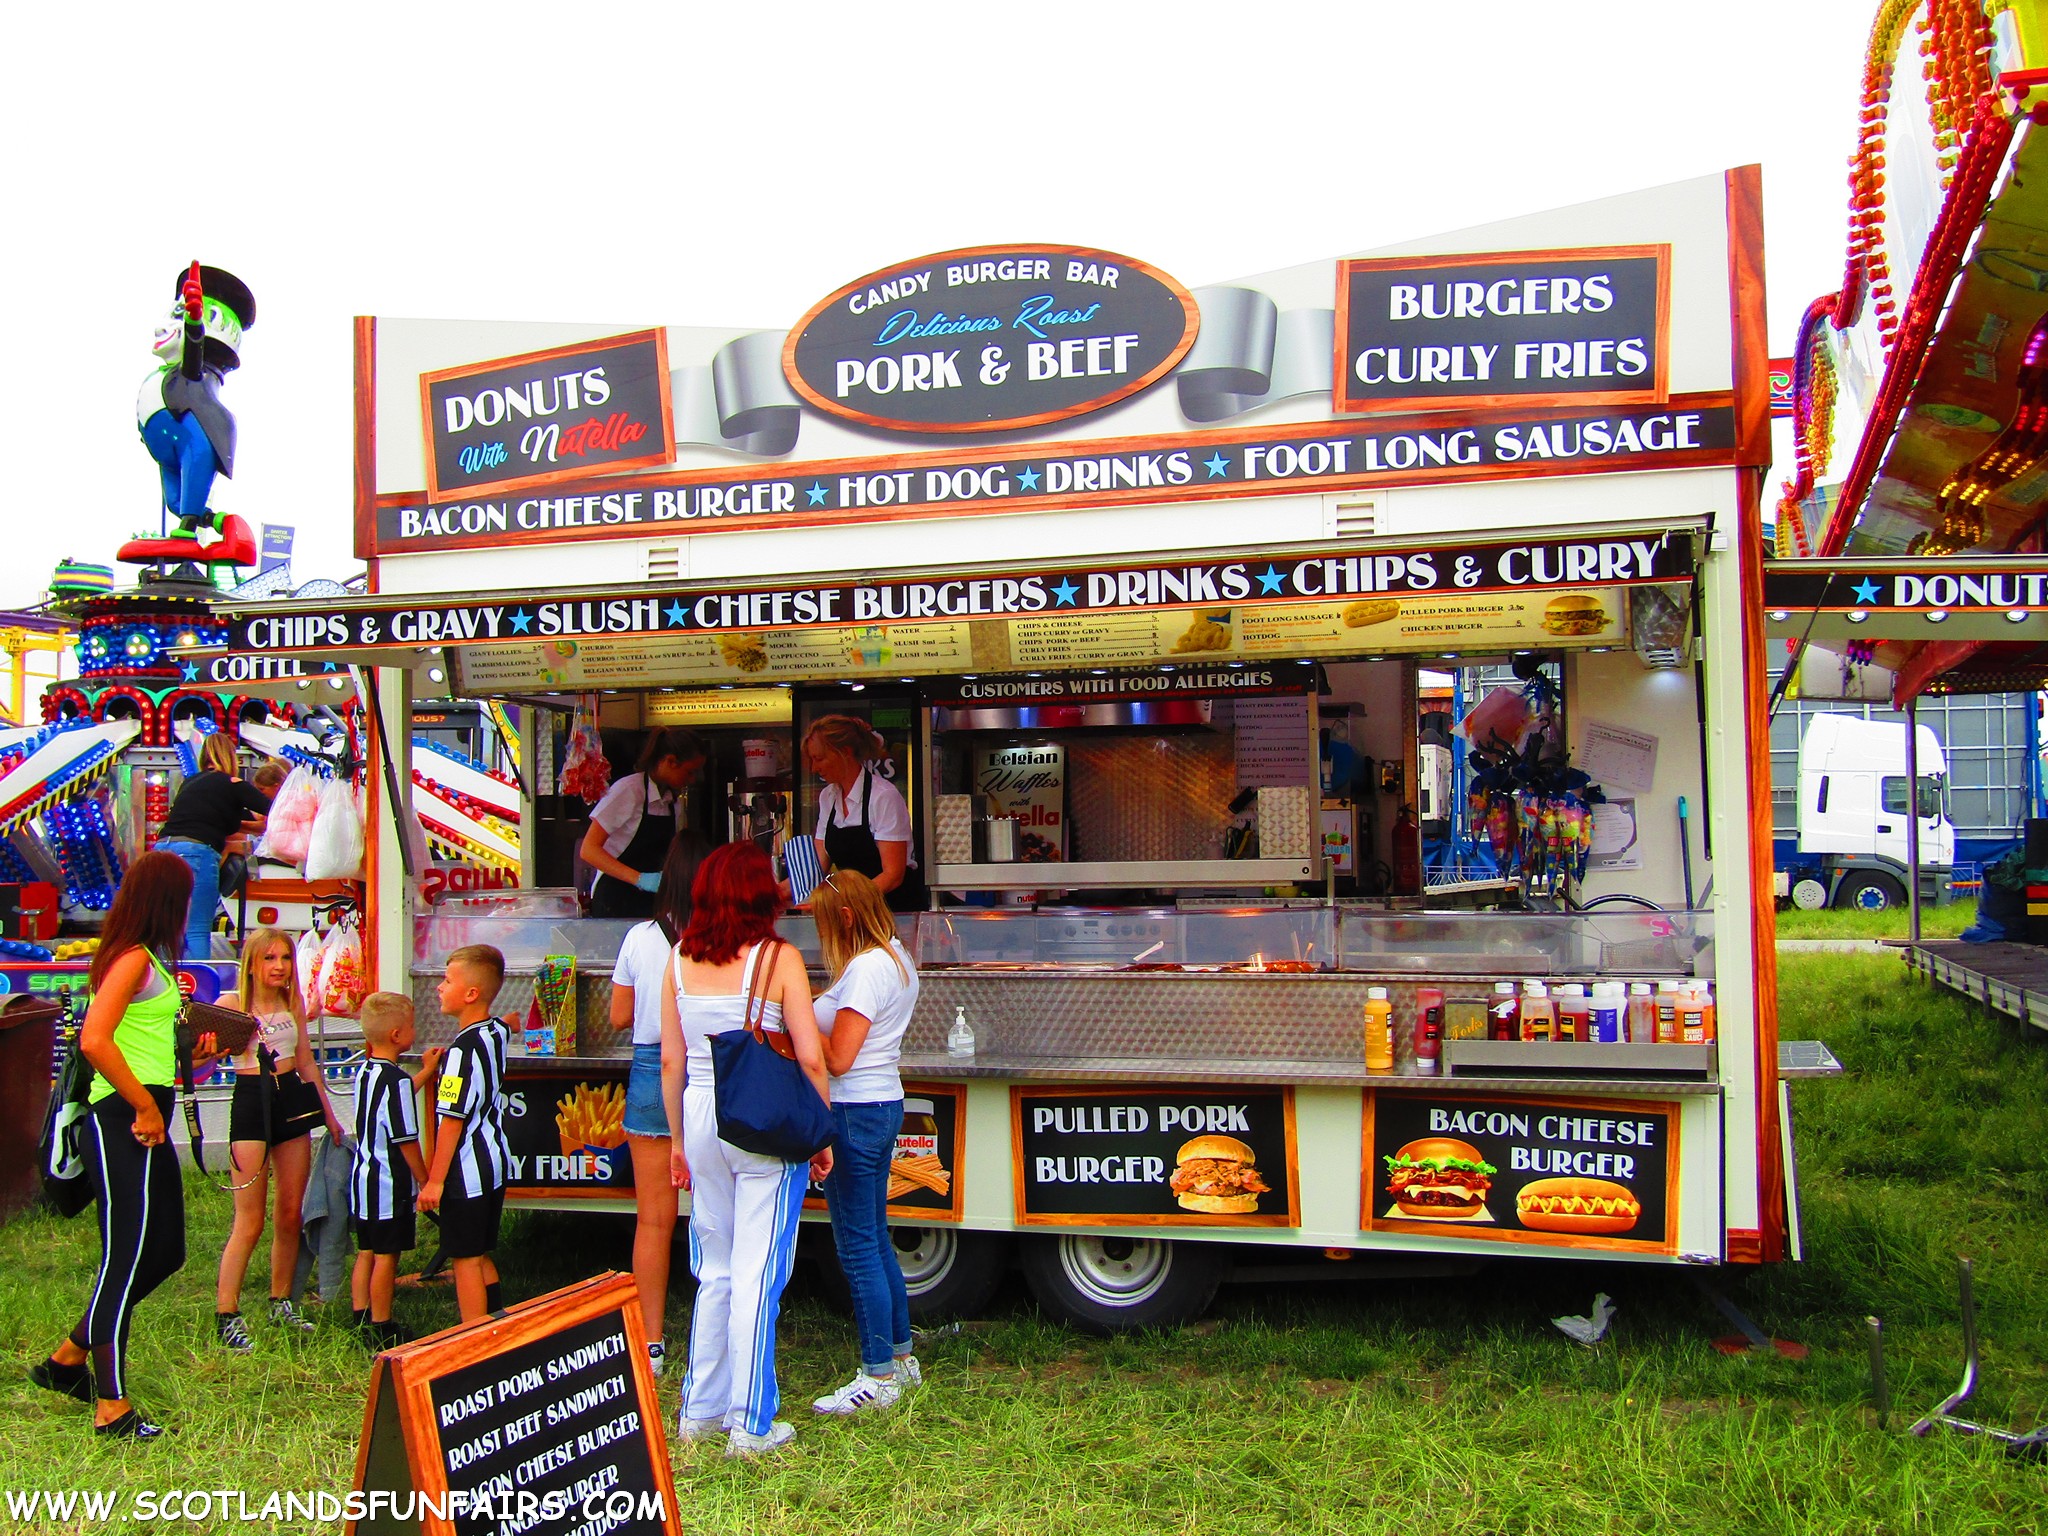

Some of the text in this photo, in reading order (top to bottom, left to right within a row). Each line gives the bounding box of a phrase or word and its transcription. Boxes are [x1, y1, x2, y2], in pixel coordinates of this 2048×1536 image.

[848, 259, 1119, 315] CANDY BURGER BAR
[1389, 274, 1613, 321] BURGERS
[873, 295, 1101, 346] Delicious Roast
[836, 334, 1139, 398] PORK & BEEF
[1355, 337, 1647, 384] CURLY FRIES
[445, 366, 610, 433] DONUTS
[458, 412, 648, 474] With Nutella
[1244, 415, 1700, 480] FOOT LONG SAUSAGE
[839, 465, 1009, 508] HOT DOG
[1046, 452, 1193, 493] DRINKS
[401, 482, 796, 538] BACON CHEESE BURGER
[1088, 564, 1250, 607] DRINKS
[1292, 540, 1660, 595] CHIPS & CURRY
[694, 576, 1047, 628] CHEESE BURGERS
[1894, 575, 2048, 606] DONUT
[247, 606, 504, 649] CHIPS & GRAVY
[538, 600, 659, 634] SLUSH
[1401, 624, 1448, 632] CHICKEN
[472, 660, 531, 668] MARSHMALLOWS
[960, 671, 1273, 698] CUSTOMERS WITH FOOD ALLERGIES
[989, 751, 1058, 766] Belgian
[977, 768, 1061, 793] Waffles
[1009, 797, 1032, 807] with
[1326, 844, 1350, 855] Slush
[1033, 1104, 1250, 1134] PULLED PORK
[1429, 1108, 1654, 1146] BACON CHEESE
[535, 1154, 613, 1181] FRIES
[1036, 1155, 1165, 1184] BURGER
[1510, 1146, 1634, 1179] BURGER
[439, 1332, 626, 1428] ROAST PORK SANDWICH
[448, 1374, 627, 1472] ROAST BEEF SANDWICH
[515, 1439, 576, 1486] CHEESE
[577, 1411, 640, 1457] BURGER
[559, 1464, 620, 1509] BURGER
